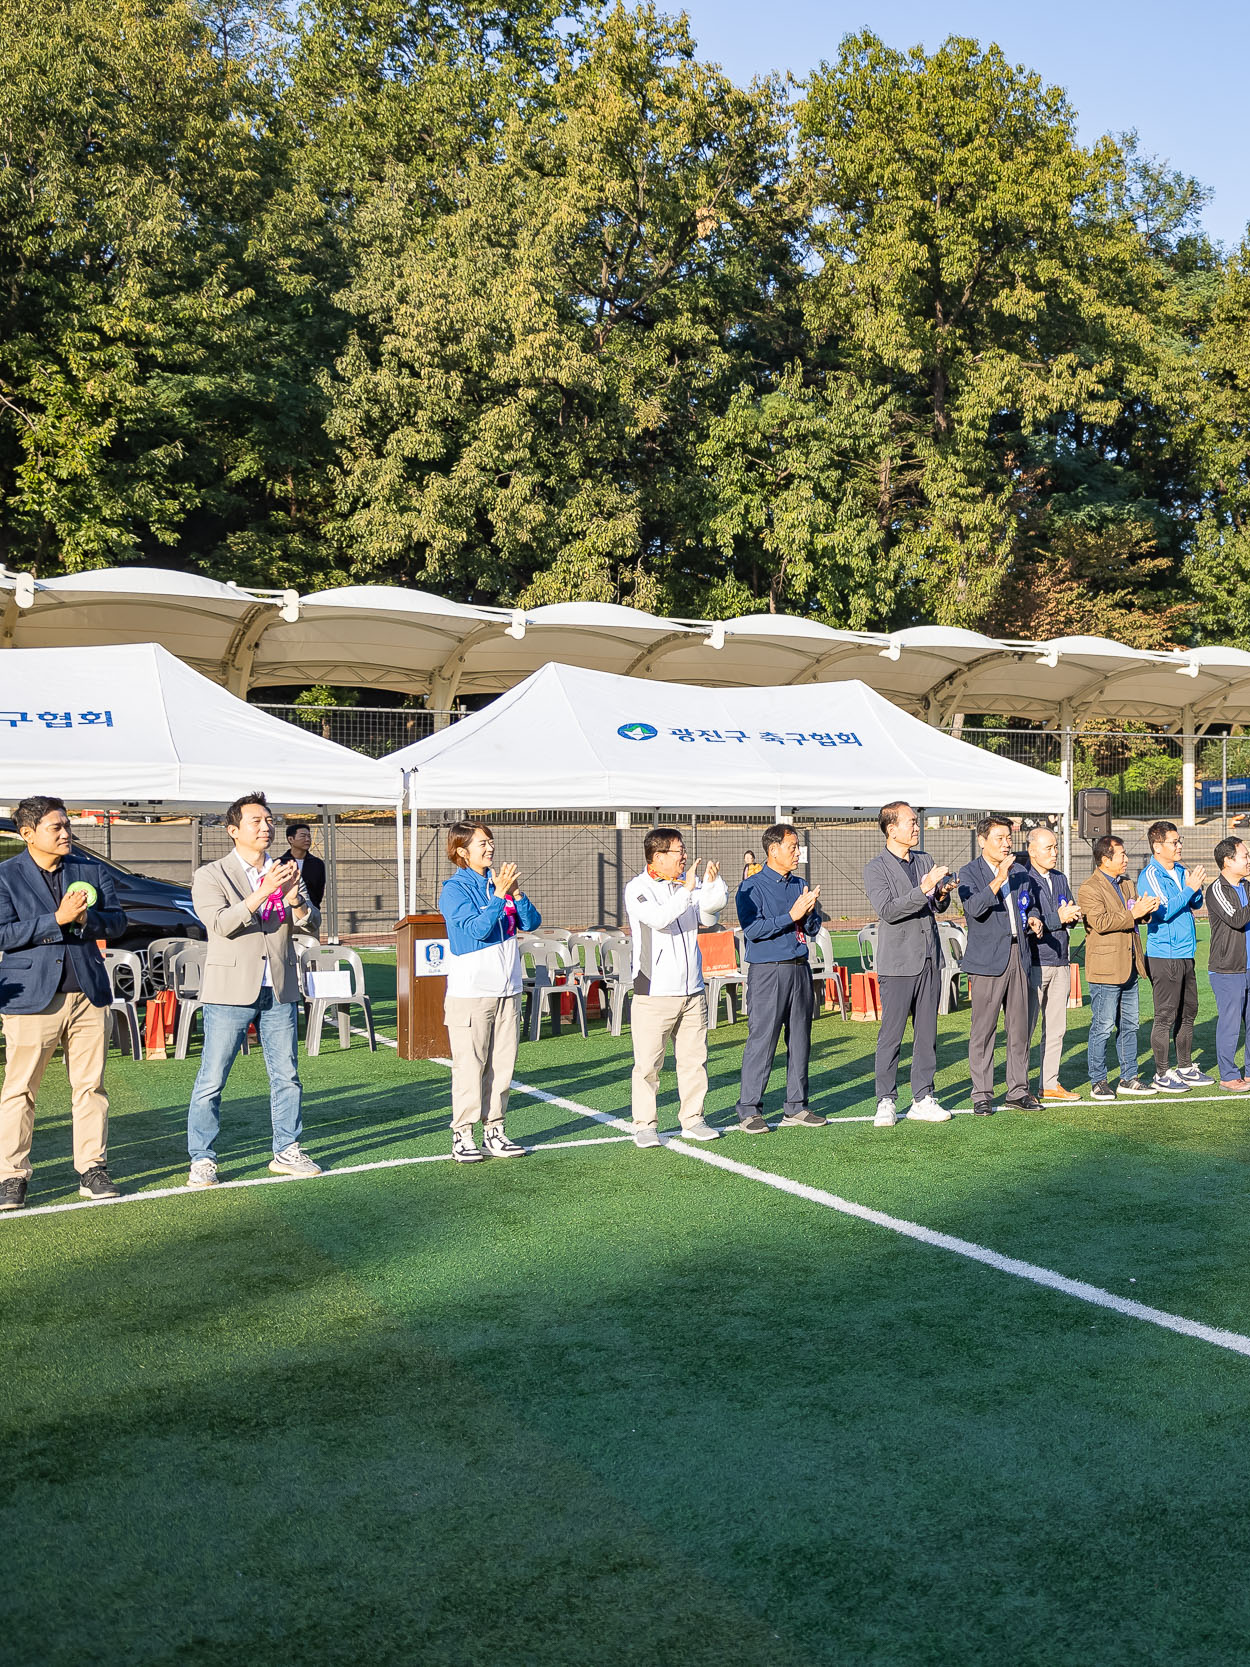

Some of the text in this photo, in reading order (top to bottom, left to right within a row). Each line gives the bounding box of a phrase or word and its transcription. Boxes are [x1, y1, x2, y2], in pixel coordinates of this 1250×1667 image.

[0, 711, 114, 728] 구협회
[668, 727, 863, 747] 광진구 축구협회
